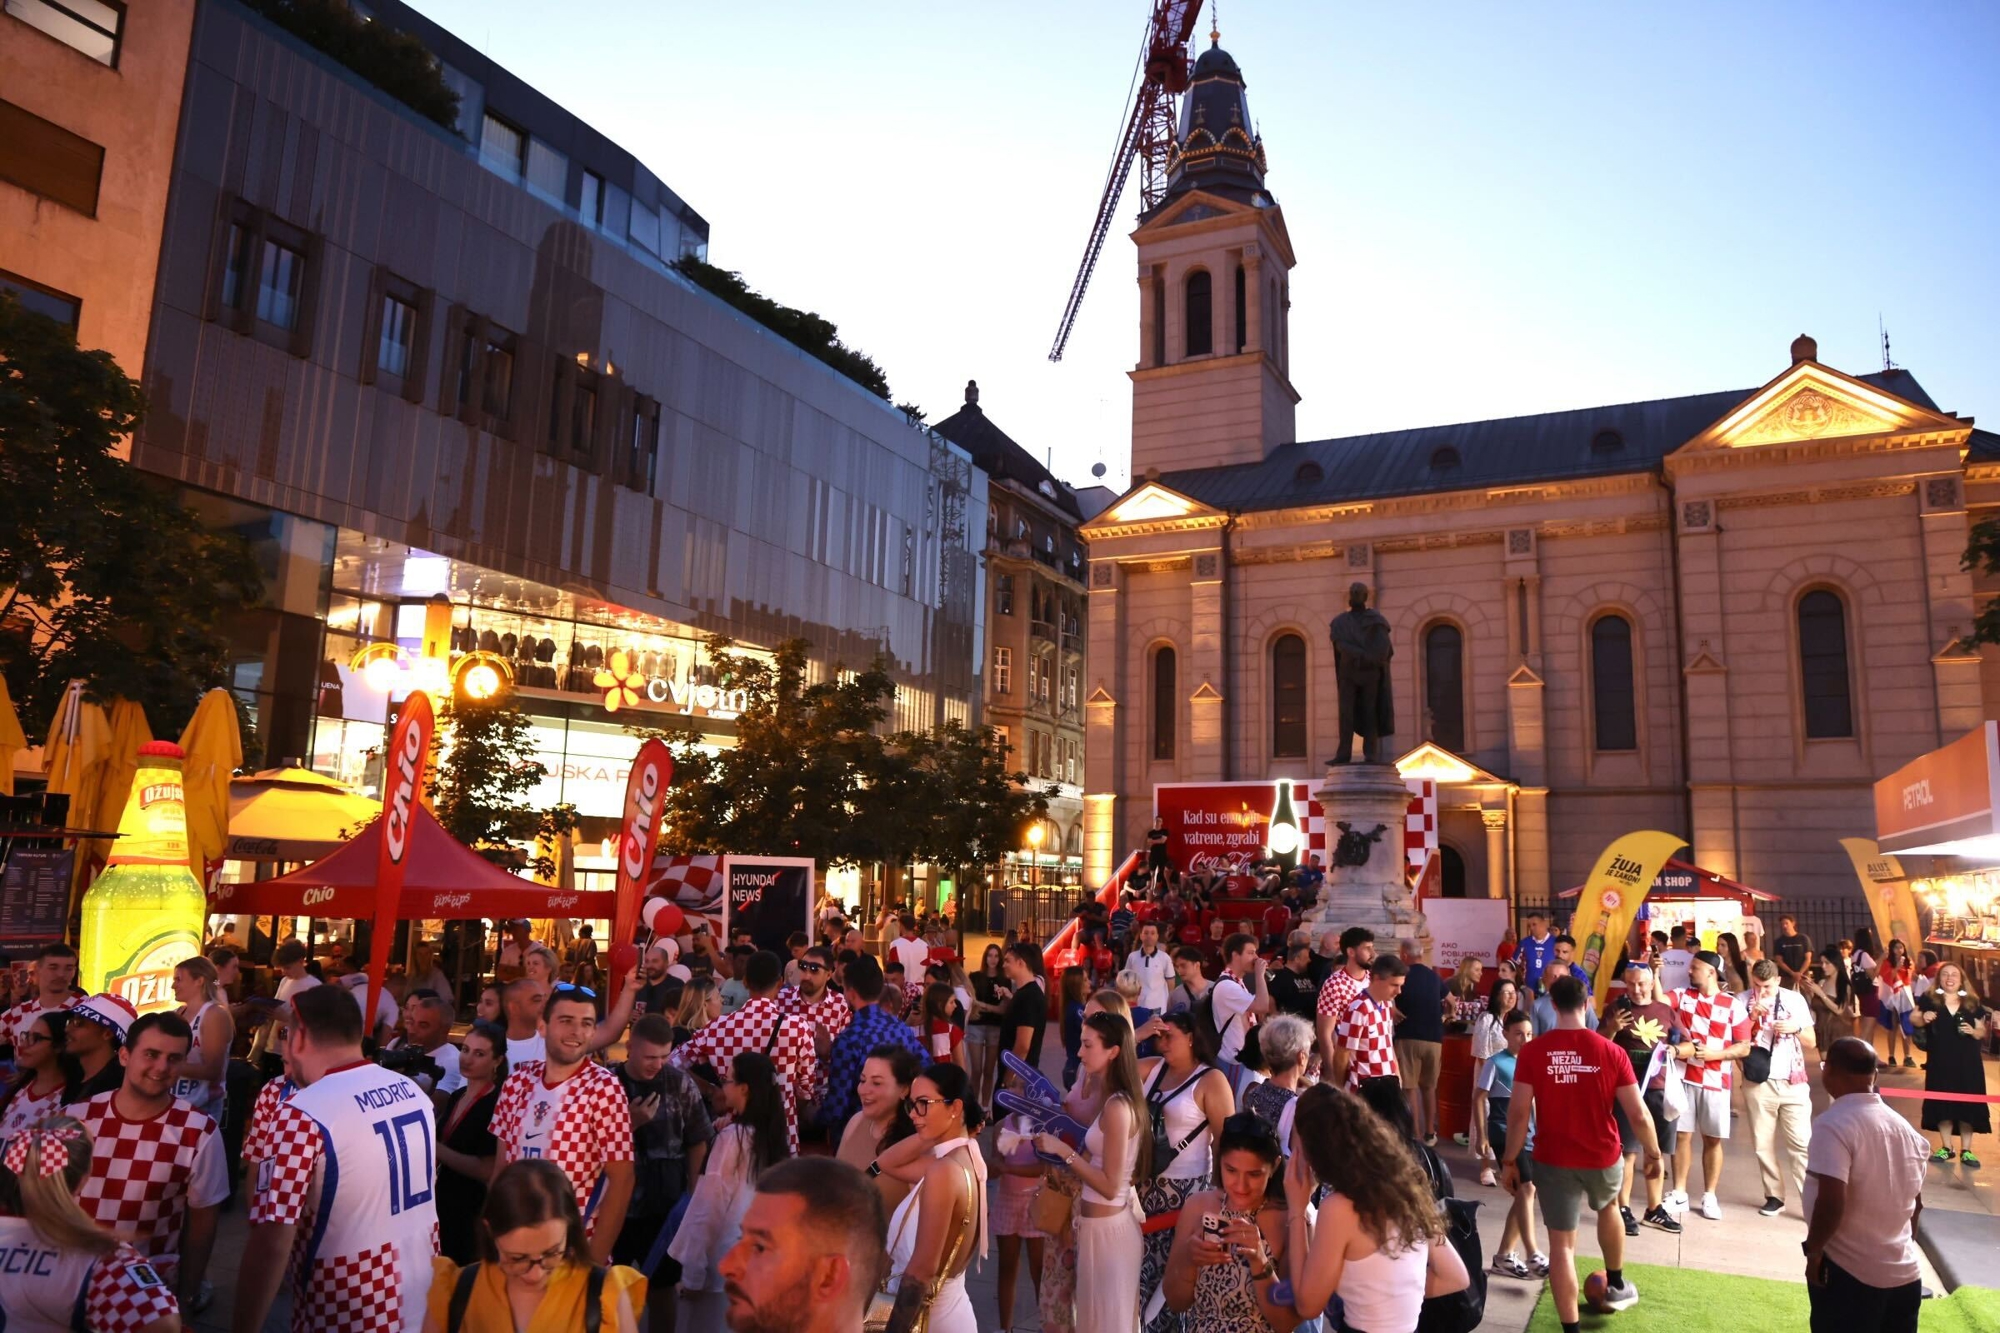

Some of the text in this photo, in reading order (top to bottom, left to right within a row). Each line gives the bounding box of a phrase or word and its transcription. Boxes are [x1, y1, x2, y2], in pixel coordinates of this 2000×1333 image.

[387, 720, 420, 861] Chio
[1903, 779, 1934, 812] PETROL
[625, 763, 658, 879] Chio
[1183, 809, 1203, 825] Kad
[1205, 813, 1217, 825] su
[1183, 830, 1260, 848] vatrene, zgrabi
[1610, 853, 1642, 876] ŽUJA
[732, 873, 775, 886] HYUNDAI
[1613, 871, 1641, 884] ZAKON!
[1664, 876, 1692, 887] SHOP
[303, 886, 335, 906] Chio
[732, 889, 761, 902] NEWS
[1441, 950, 1491, 958] POBIJEDIMO
[1535, 959, 1542, 968] 9
[73, 1006, 100, 1022] SKA
[1551, 1055, 1582, 1065] NEZAU
[1547, 1065, 1571, 1075] STAV
[353, 1078, 416, 1113] MODRIĆ
[372, 1108, 433, 1216] 10
